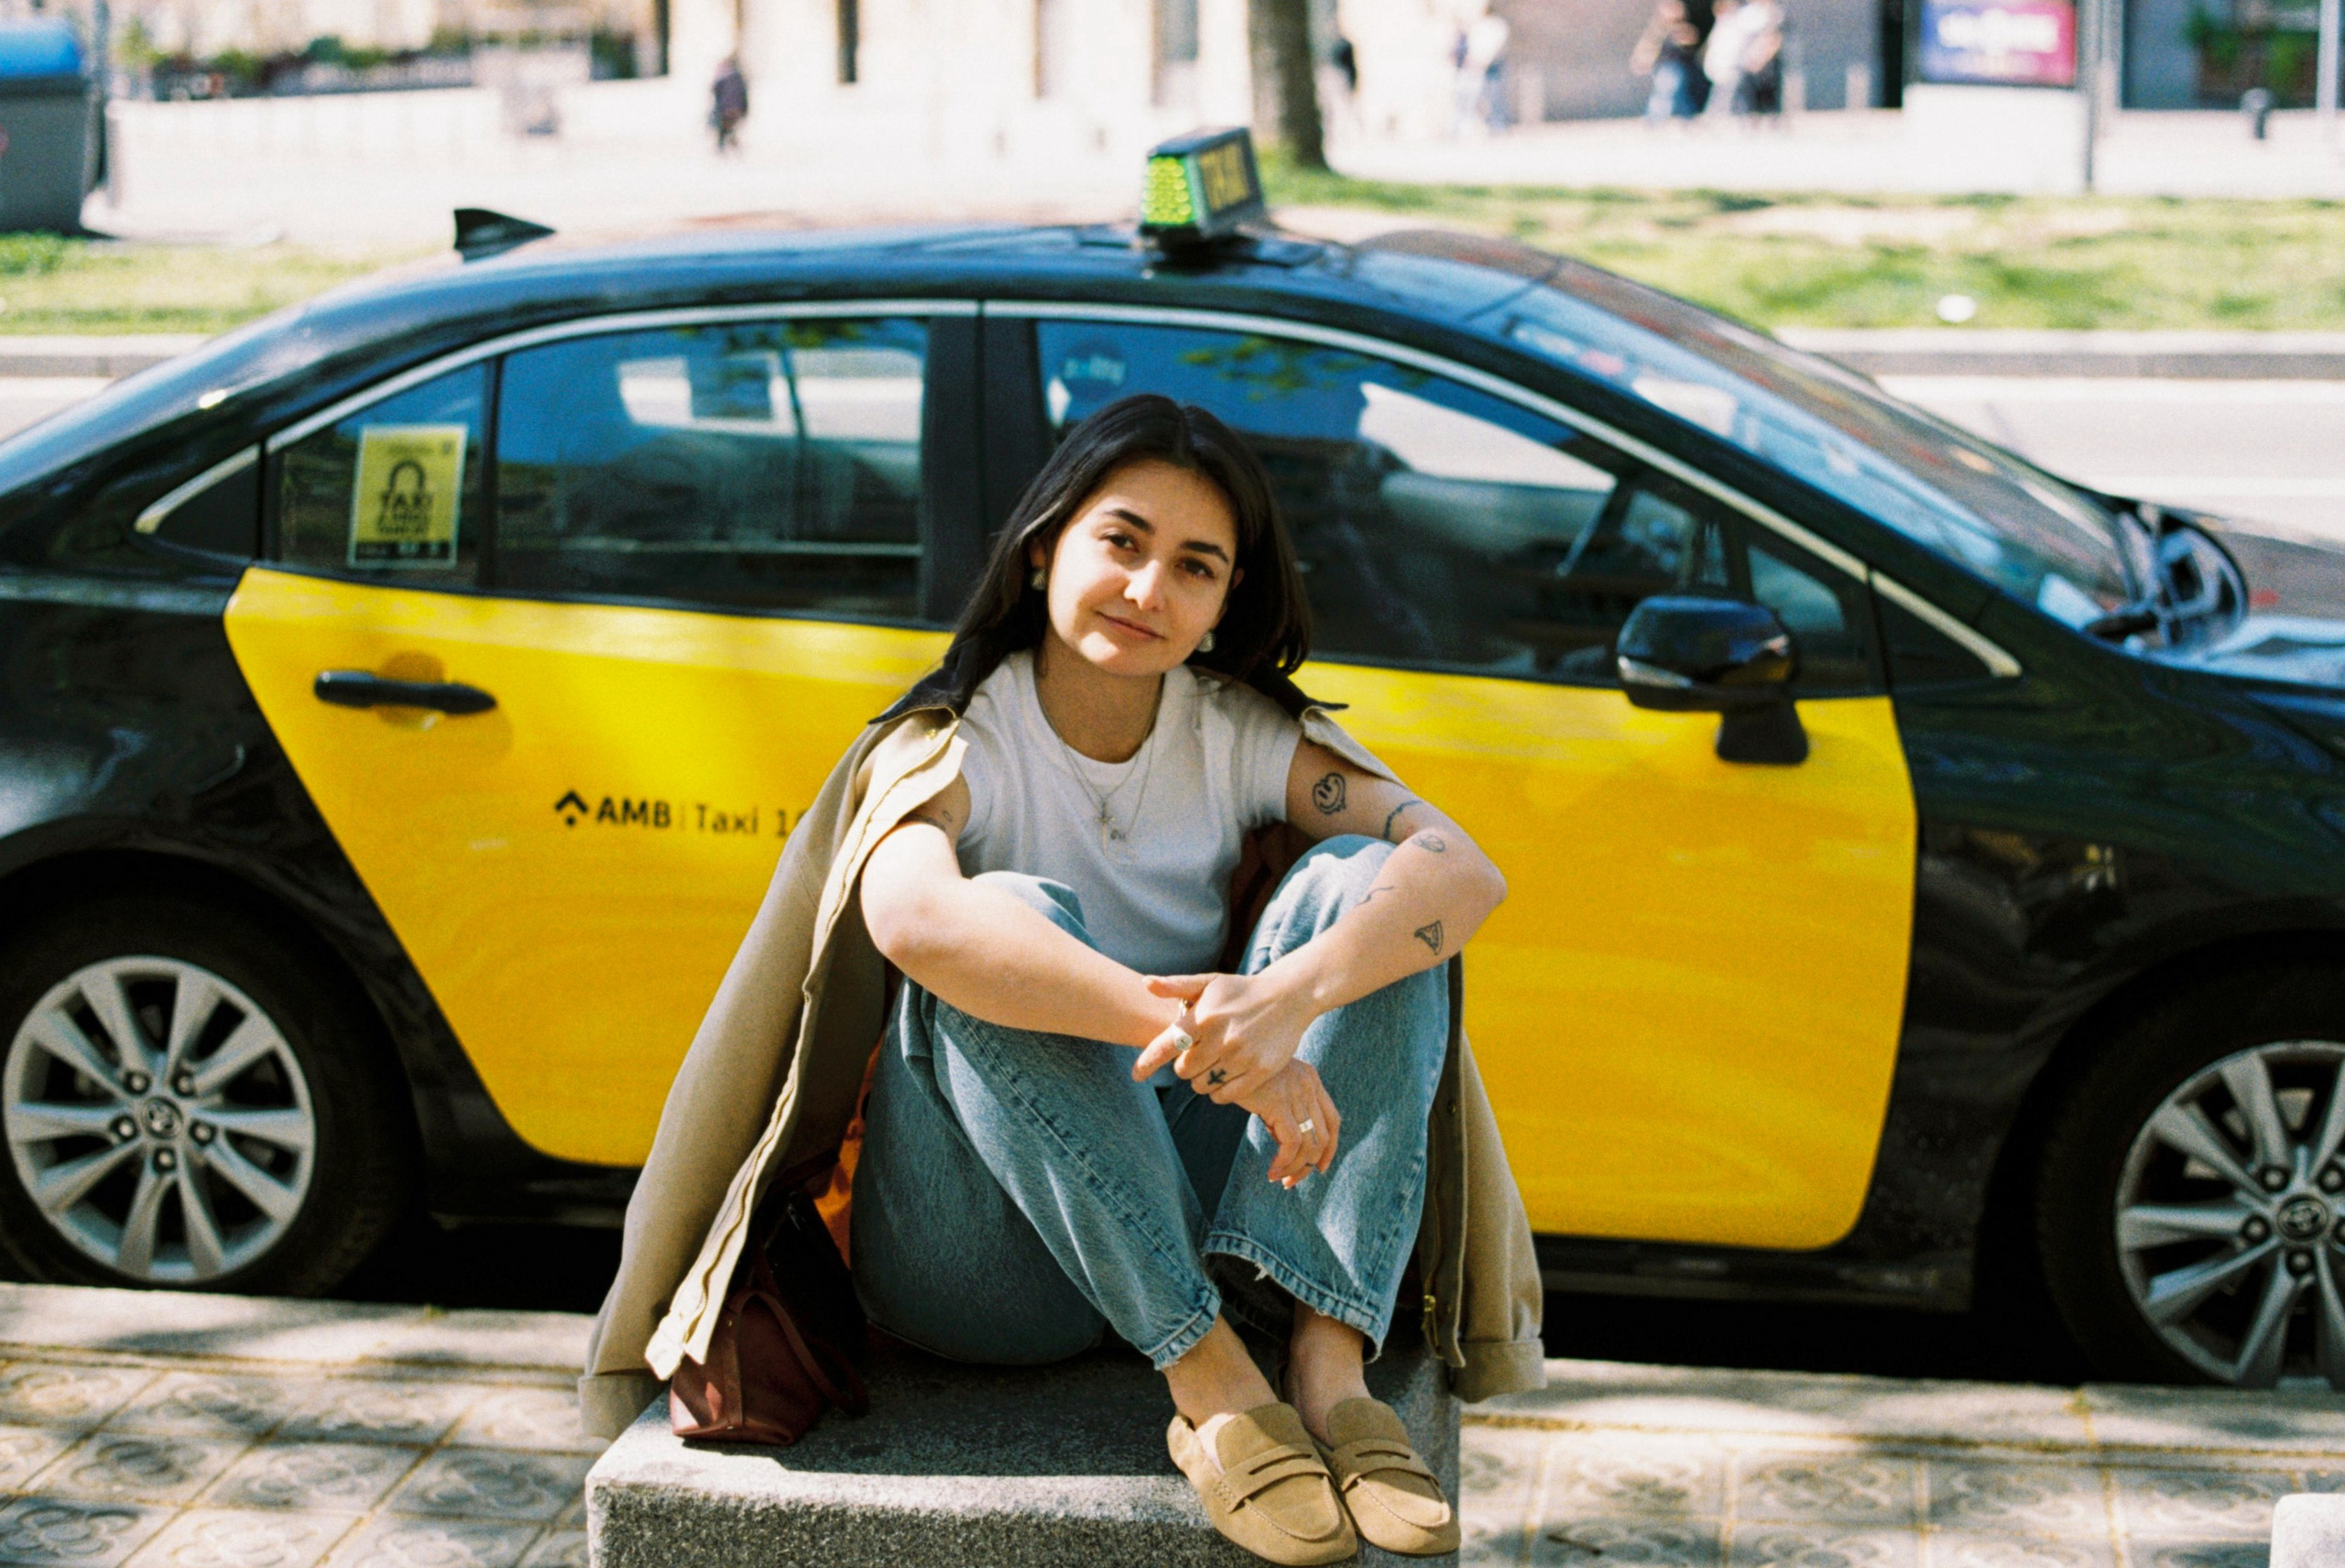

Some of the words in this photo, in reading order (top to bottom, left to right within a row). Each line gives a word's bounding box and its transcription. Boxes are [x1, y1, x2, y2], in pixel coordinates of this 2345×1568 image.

[596, 796, 671, 828] AMB
[696, 802, 758, 834] Taxi
[775, 808, 806, 837] 1
